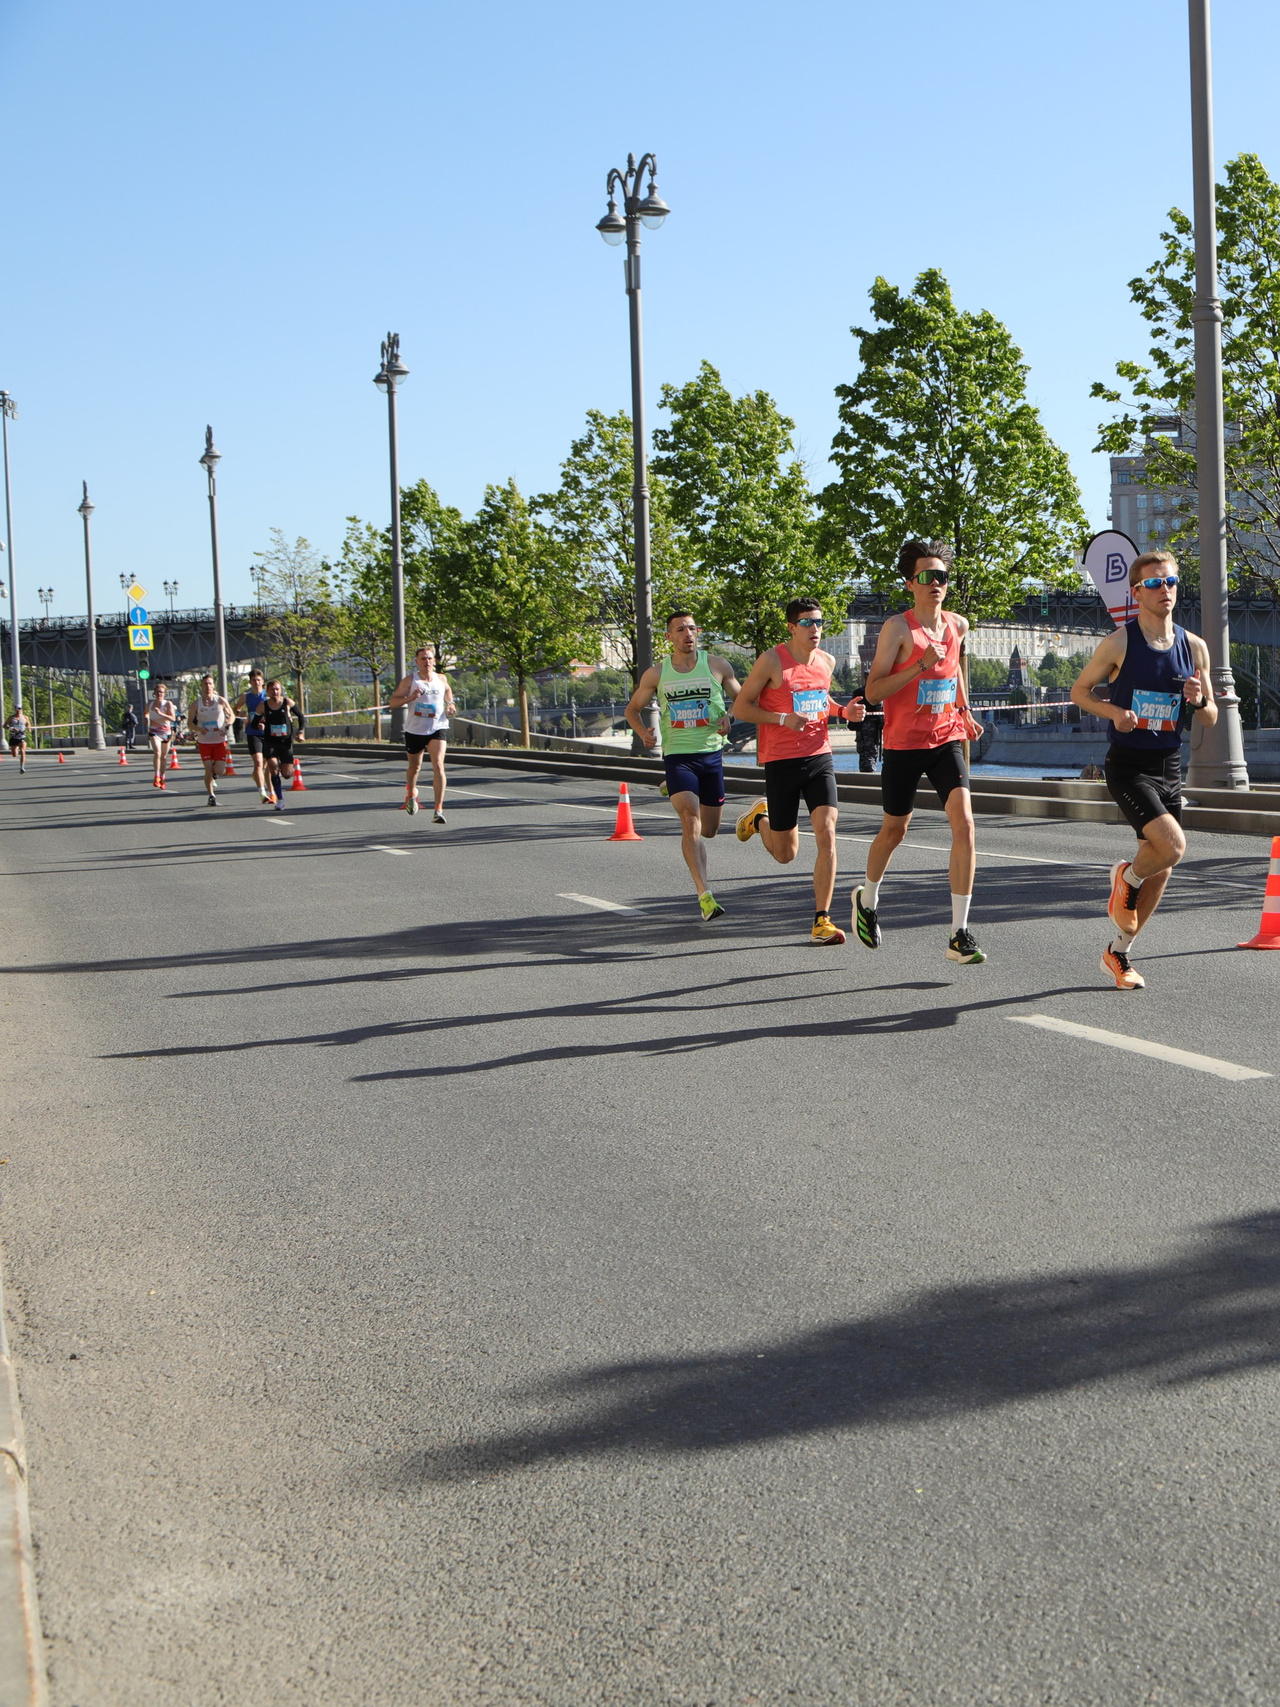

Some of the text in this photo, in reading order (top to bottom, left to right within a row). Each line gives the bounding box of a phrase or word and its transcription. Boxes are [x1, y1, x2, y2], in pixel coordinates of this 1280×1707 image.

[926, 690, 951, 703] 21806
[801, 699, 823, 712] 26774
[1141, 703, 1171, 718] 26759
[676, 709, 702, 720] 20927
